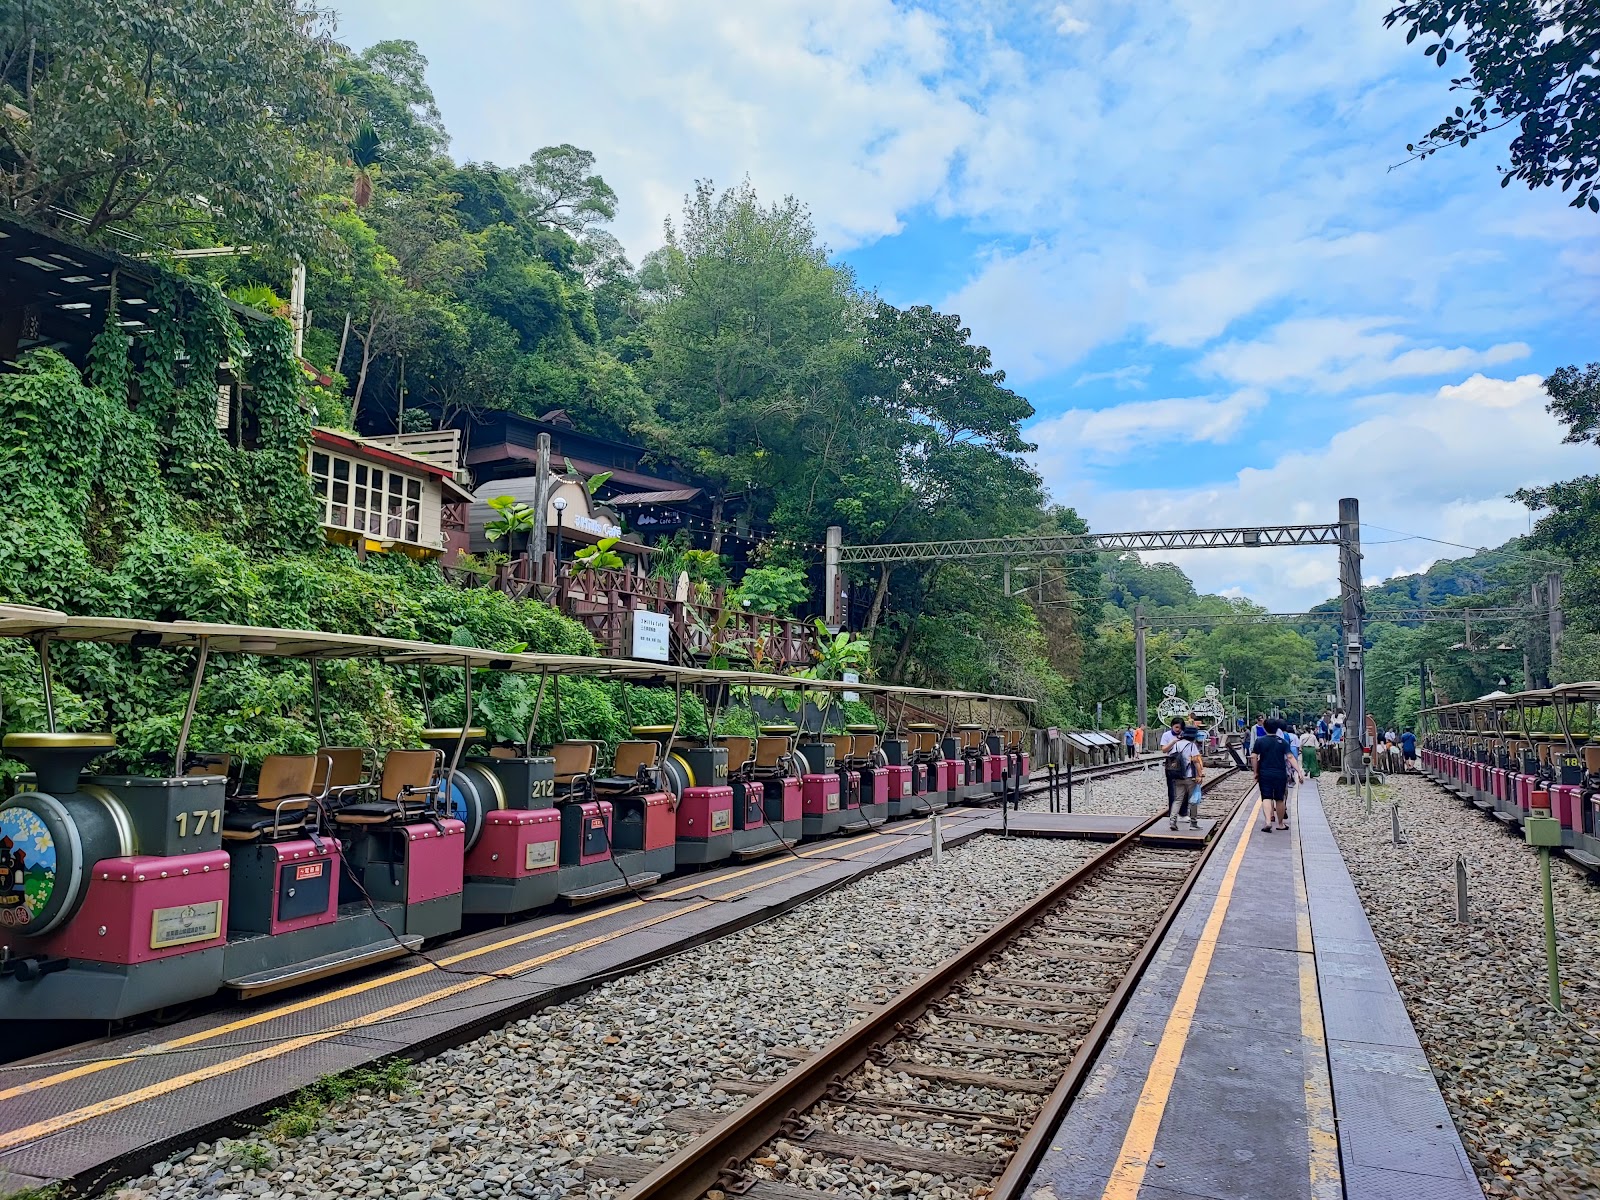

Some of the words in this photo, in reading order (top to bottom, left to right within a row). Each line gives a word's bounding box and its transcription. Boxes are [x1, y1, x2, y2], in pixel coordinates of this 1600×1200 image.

[715, 763, 729, 778] 106
[826, 756, 836, 768] 222
[531, 779, 554, 799] 212
[175, 809, 221, 838] 171
